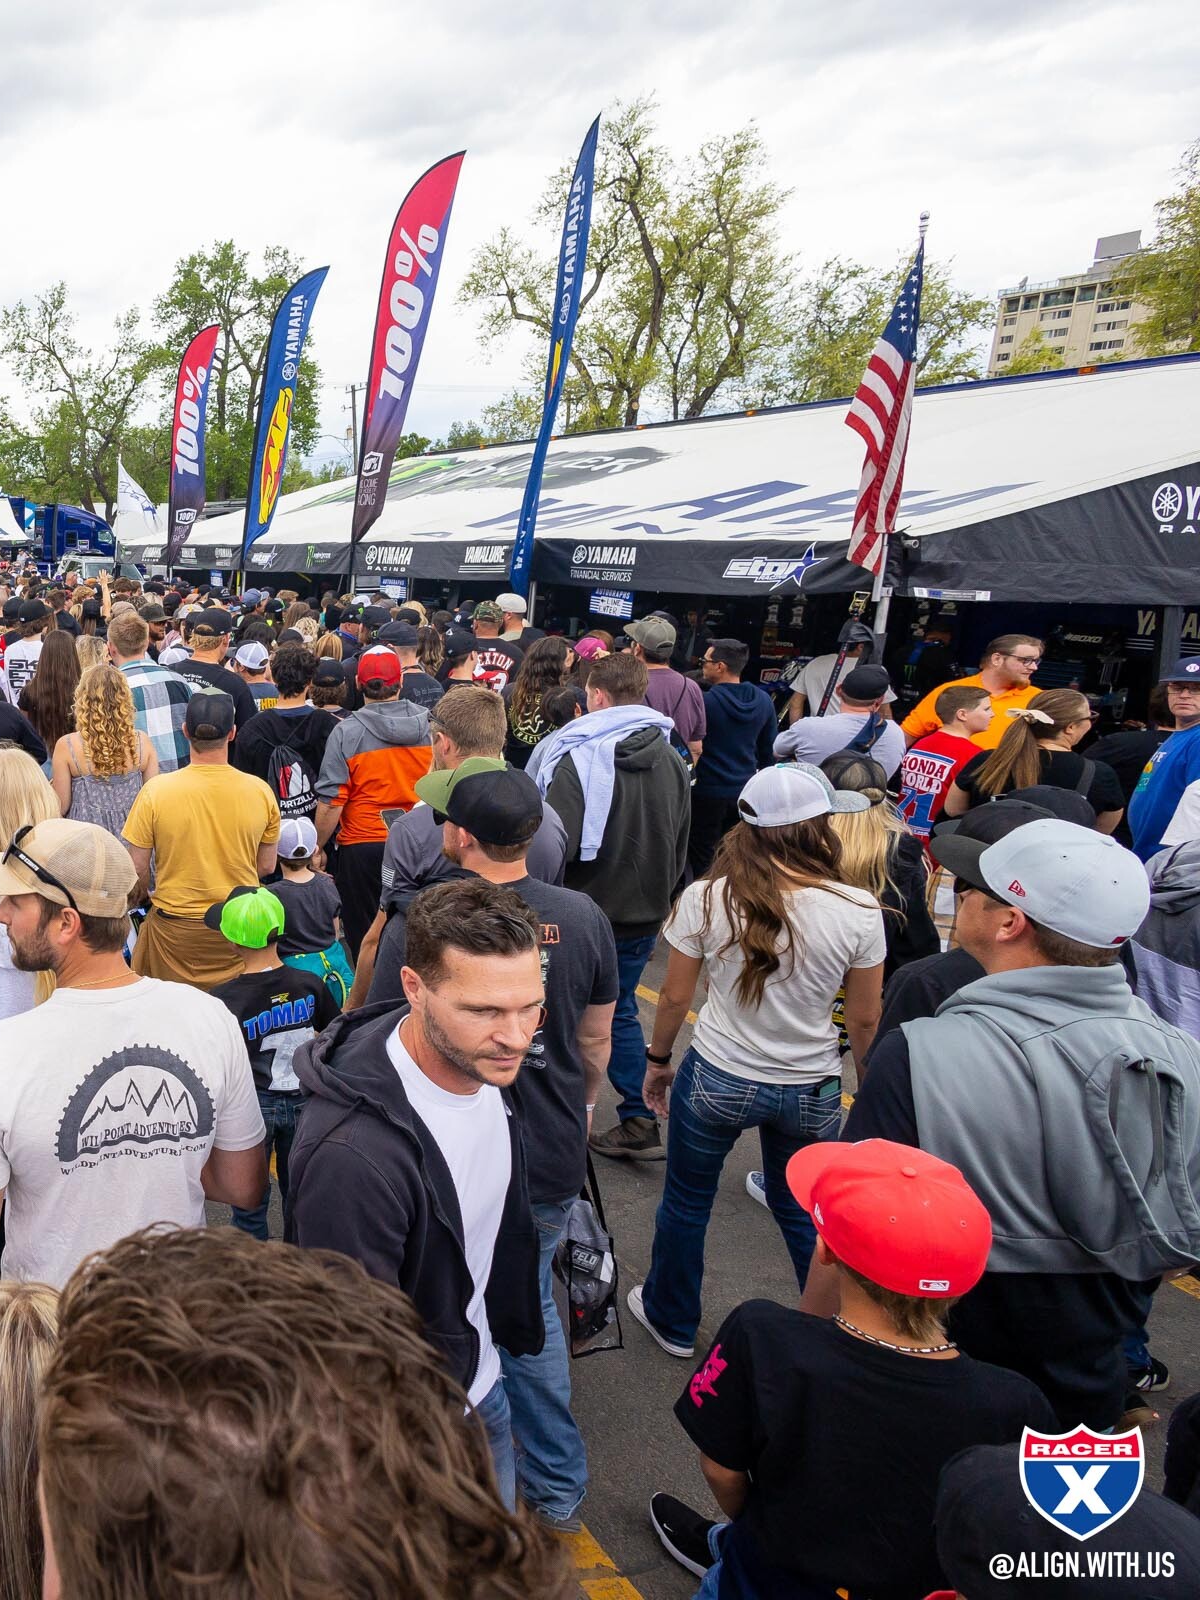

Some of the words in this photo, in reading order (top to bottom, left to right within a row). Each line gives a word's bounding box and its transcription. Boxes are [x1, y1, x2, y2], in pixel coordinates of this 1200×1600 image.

[563, 173, 583, 290] YAMAHA
[379, 223, 439, 401] 100%
[284, 294, 305, 362] YAMAHA
[175, 366, 208, 476] 100%
[377, 547, 414, 565] YAMAHA
[464, 545, 509, 563] YAMALUBE
[586, 545, 637, 565] YAMAHA
[367, 565, 406, 573] RACING
[570, 569, 600, 581] FINANCIAL
[601, 570, 633, 582] SERVICES
[478, 651, 515, 671] EXTON
[902, 755, 947, 779] HONDA
[243, 994, 315, 1040] TOMAC
[81, 1132, 103, 1148] WIL
[104, 1123, 132, 1140] POINT
[133, 1120, 193, 1139] ADVENTUES
